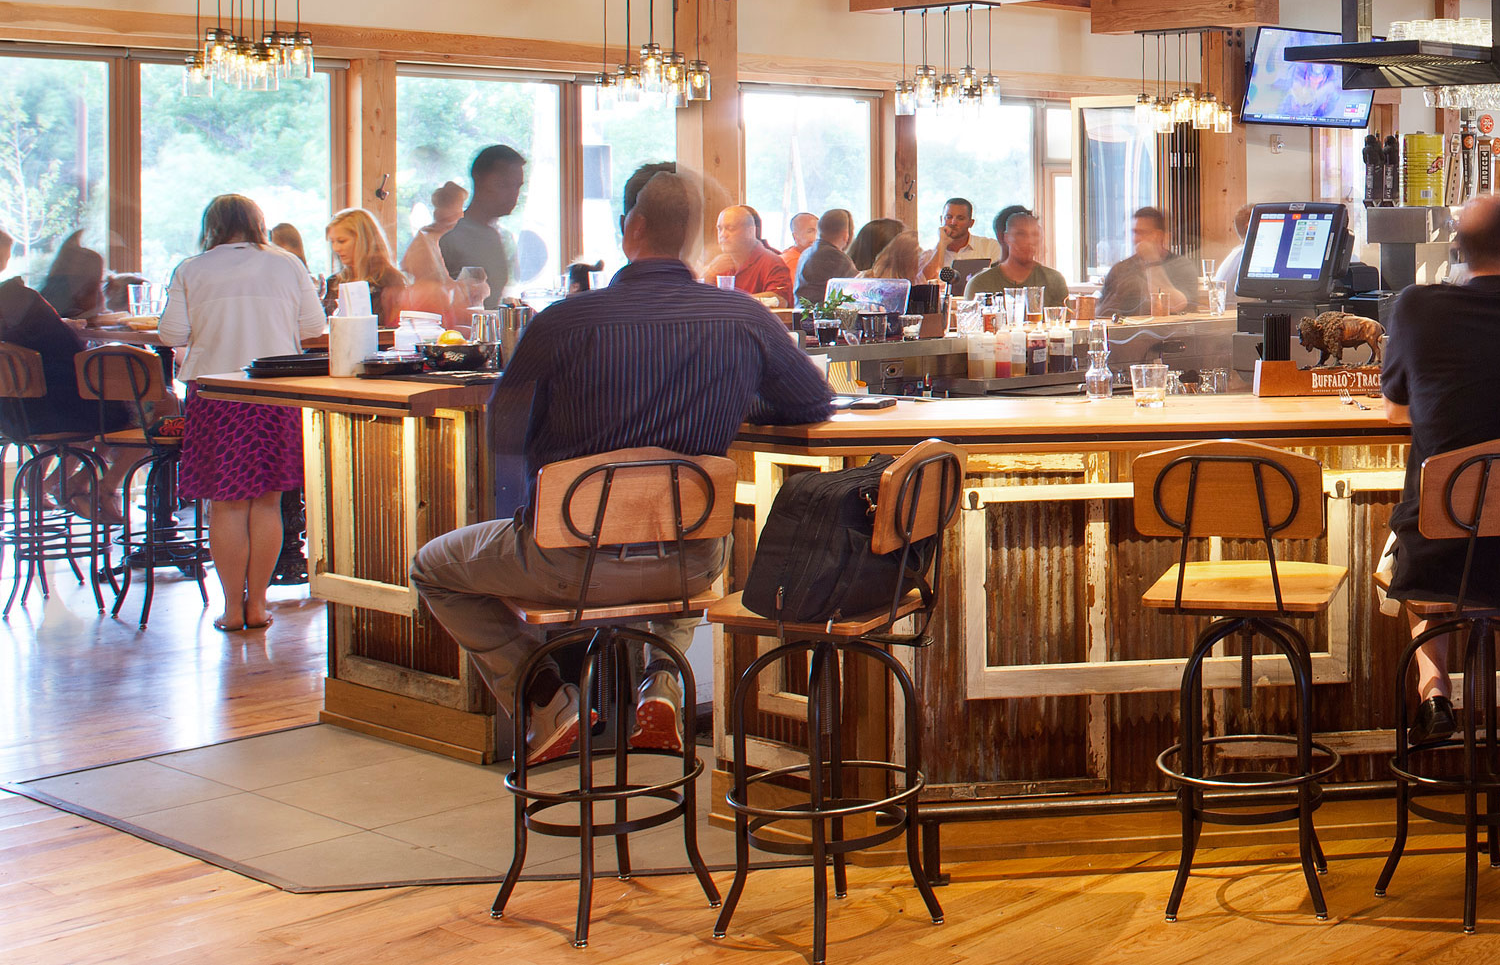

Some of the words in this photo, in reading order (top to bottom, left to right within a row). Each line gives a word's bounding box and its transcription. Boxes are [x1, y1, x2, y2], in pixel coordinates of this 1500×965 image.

[1481, 151, 1489, 185] THUNDER
[1312, 373, 1348, 388] BUFFALO
[1356, 372, 1382, 388] TRACE
